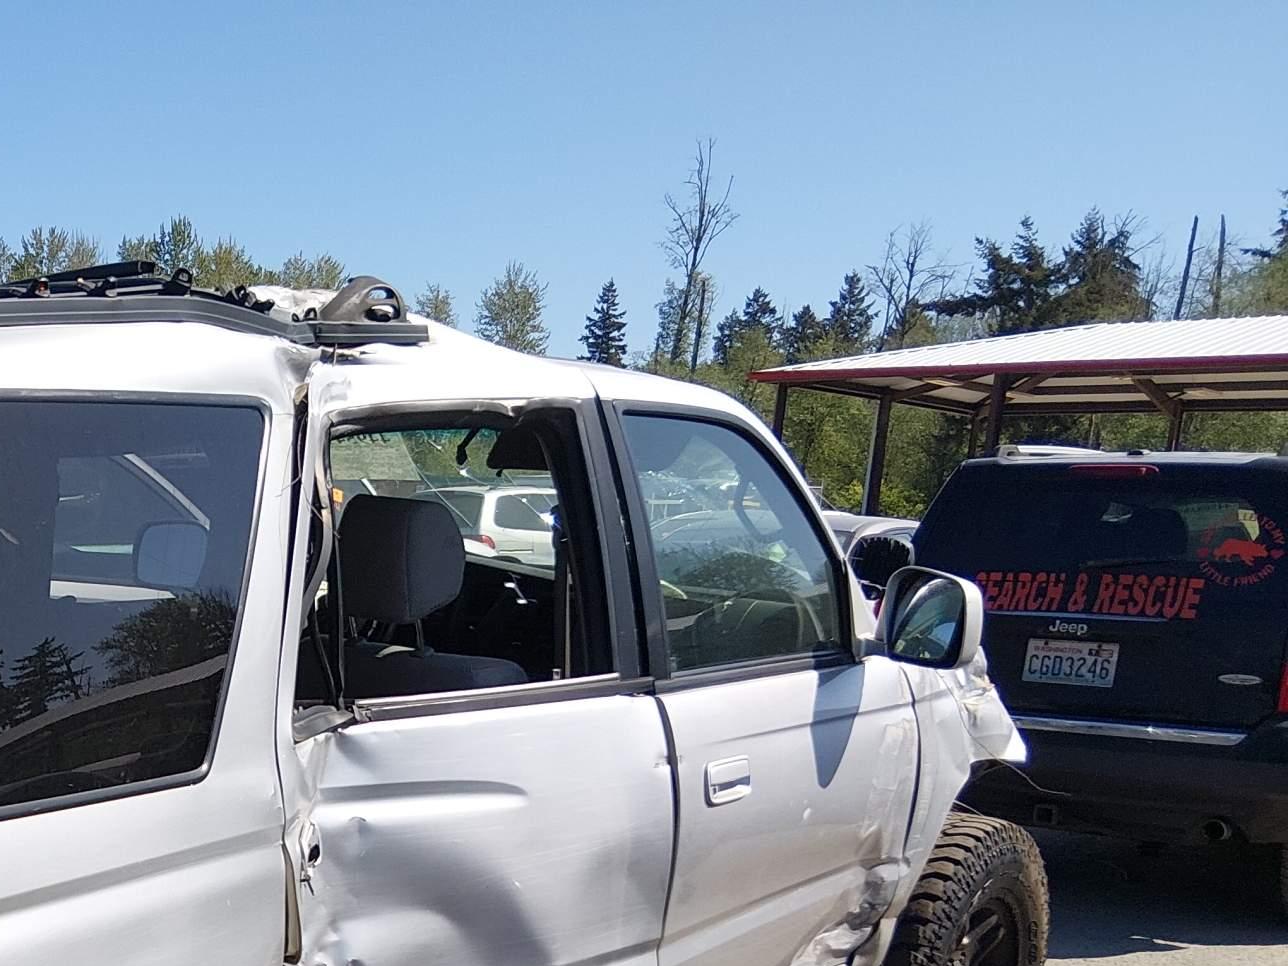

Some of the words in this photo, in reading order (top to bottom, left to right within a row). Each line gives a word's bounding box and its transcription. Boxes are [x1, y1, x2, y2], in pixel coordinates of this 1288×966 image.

[1068, 572, 1088, 612] &
[1092, 574, 1205, 620] RESCUE
[1049, 619, 1088, 636] Jeep
[1028, 654, 1111, 680] CGD3246
